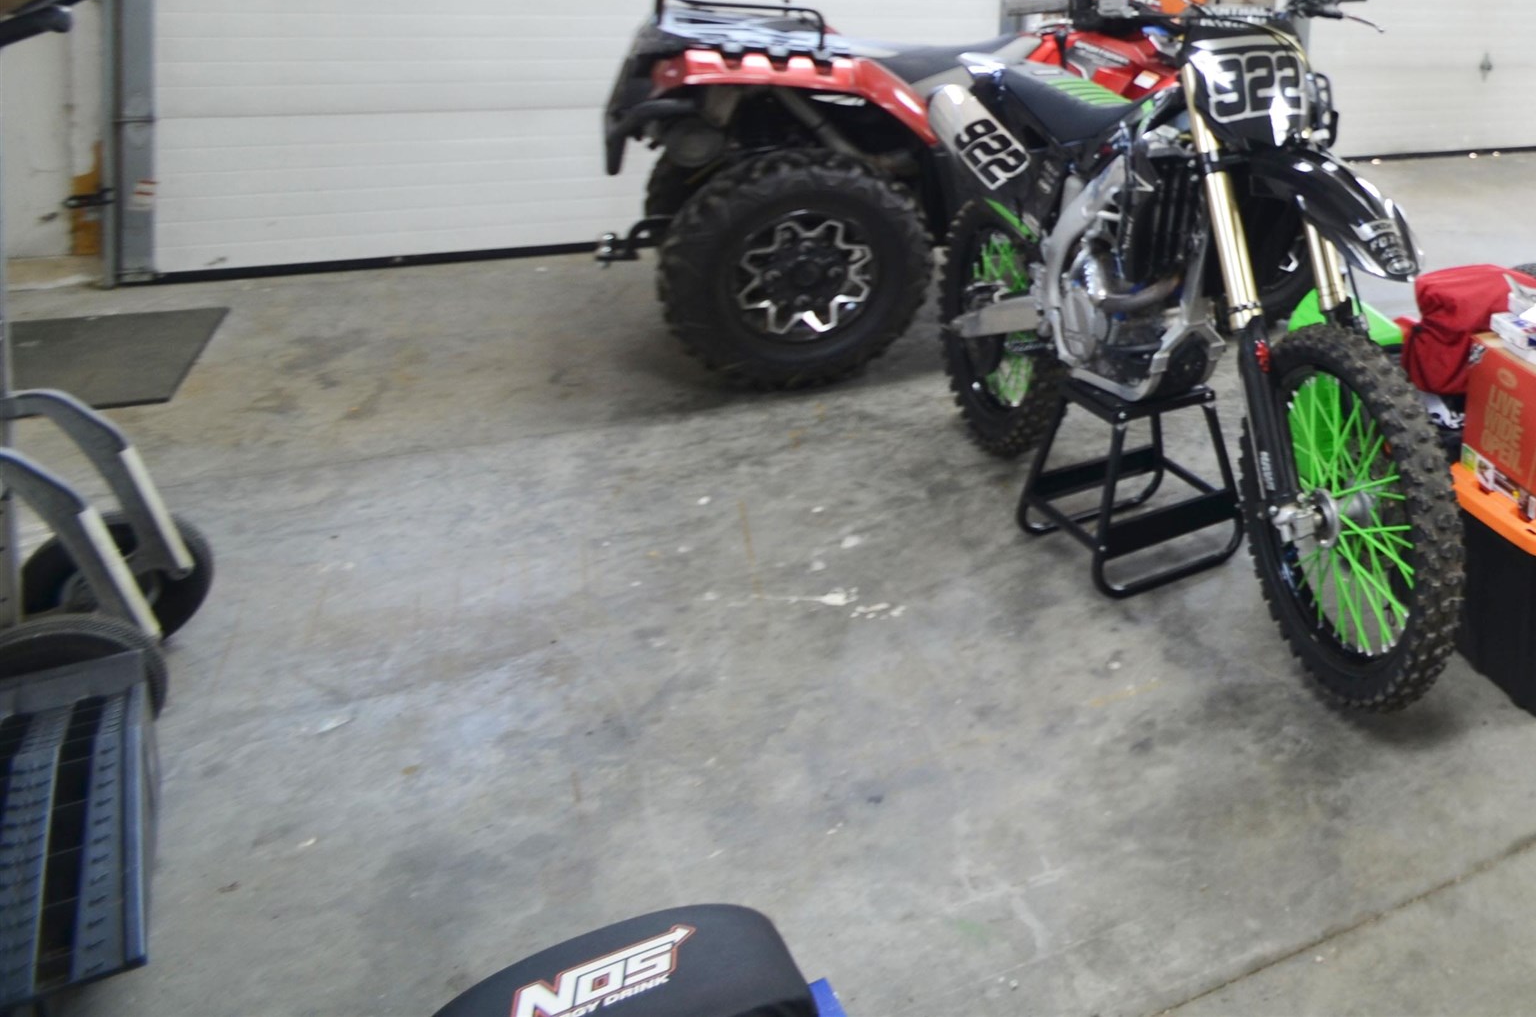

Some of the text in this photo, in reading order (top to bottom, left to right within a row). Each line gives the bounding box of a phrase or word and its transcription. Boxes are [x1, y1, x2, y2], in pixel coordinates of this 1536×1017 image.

[955, 119, 1029, 189] 922
[511, 924, 696, 1017] NOS
[603, 974, 670, 1006] DRINK
